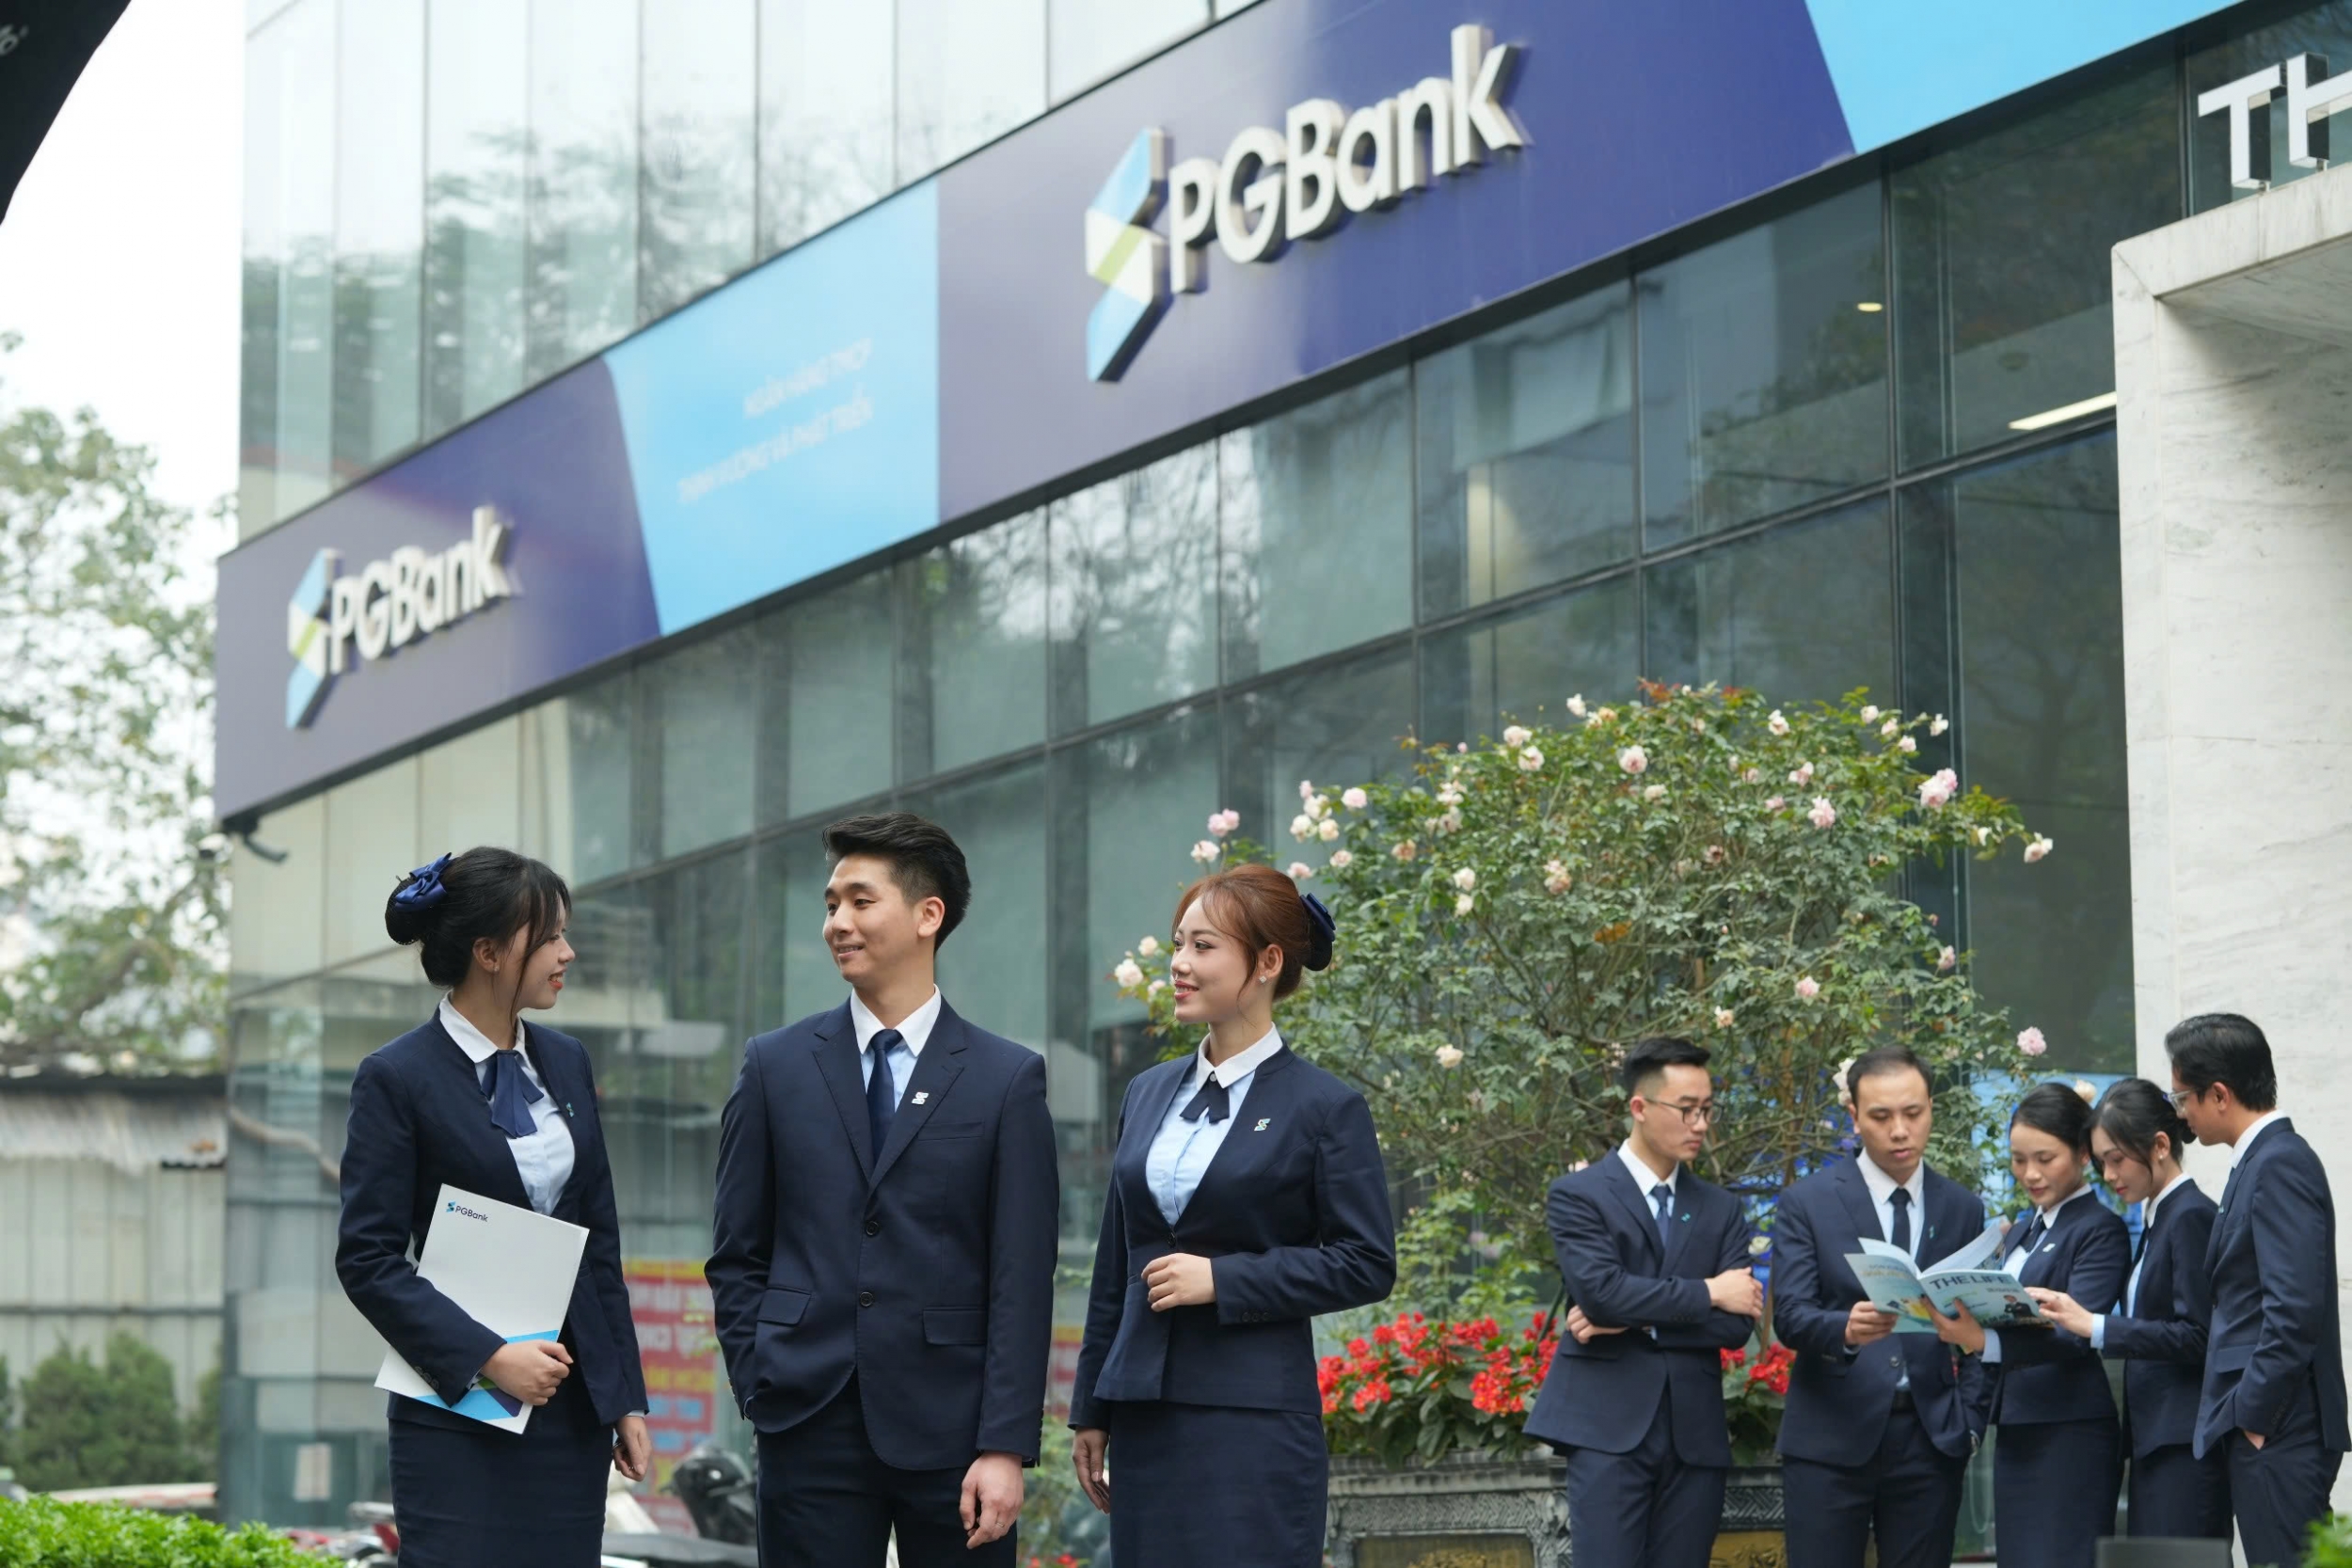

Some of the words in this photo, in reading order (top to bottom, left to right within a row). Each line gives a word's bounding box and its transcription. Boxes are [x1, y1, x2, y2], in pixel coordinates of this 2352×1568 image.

[1168, 24, 1524, 294] PGBank
[331, 506, 512, 674] PGBank
[455, 1205, 488, 1222] PGBank
[1930, 1275, 1968, 1290] THE
